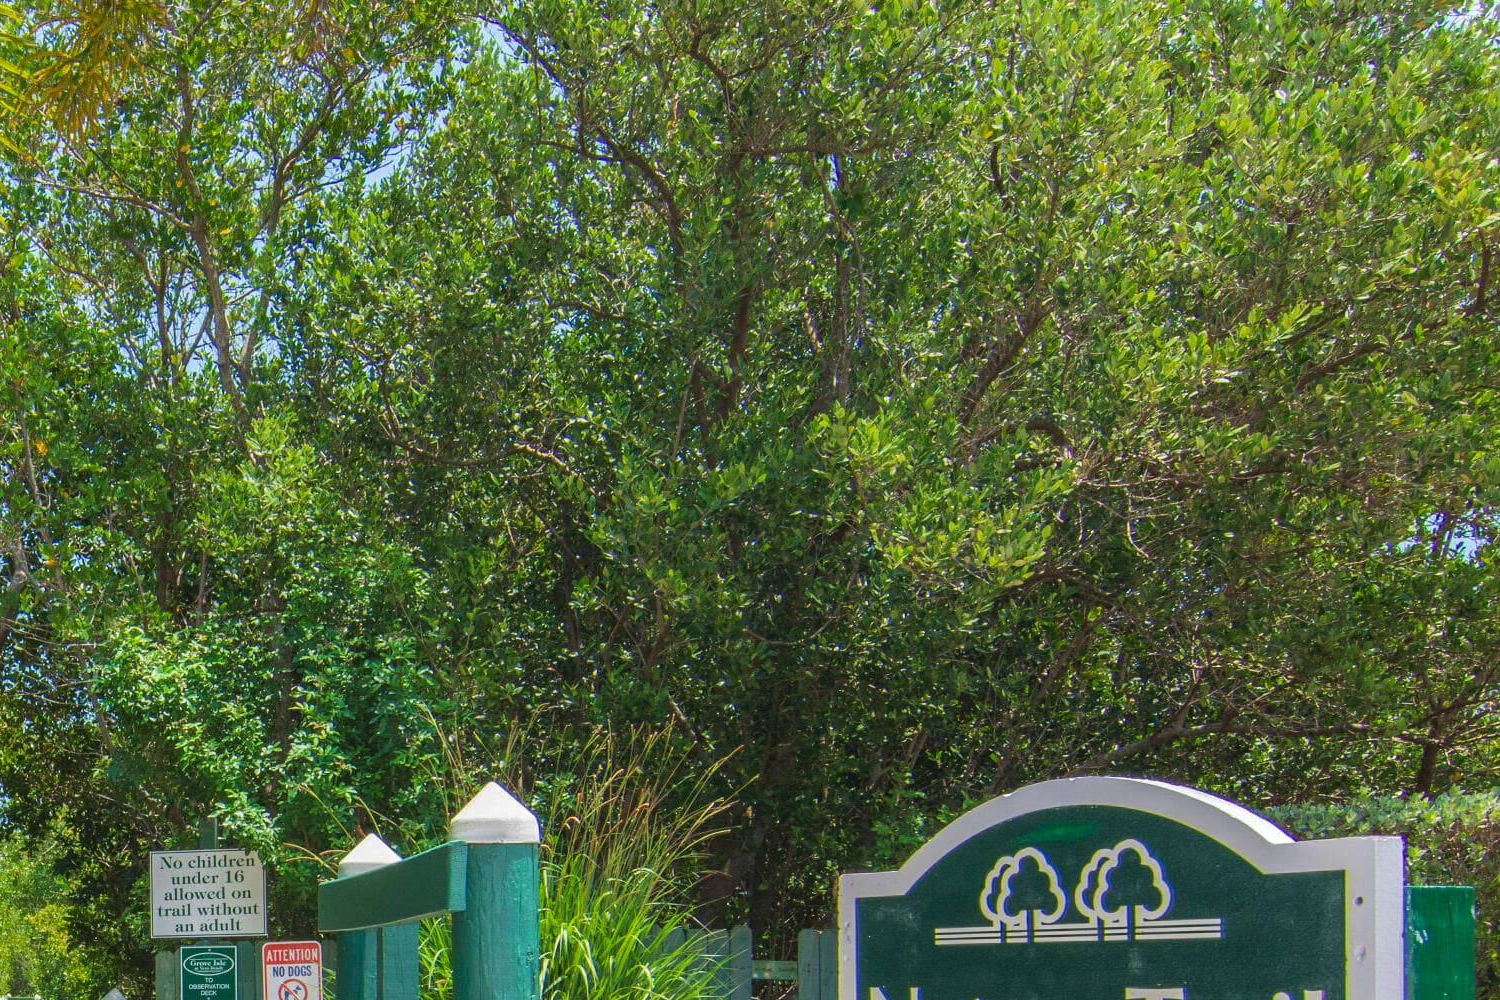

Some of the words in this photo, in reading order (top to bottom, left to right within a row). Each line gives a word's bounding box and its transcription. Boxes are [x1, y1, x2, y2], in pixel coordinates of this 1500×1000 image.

[160, 856, 183, 869] No
[188, 855, 255, 868] children
[171, 872, 219, 885] under
[226, 870, 244, 883] 16
[165, 887, 226, 900] allowed
[232, 889, 252, 899] on
[158, 904, 192, 917] trail
[197, 903, 260, 915] without
[175, 923, 194, 932] an
[200, 918, 241, 931] adult
[266, 948, 318, 961] ATTENTION
[273, 966, 285, 977] NO
[288, 966, 312, 976] DOGS
